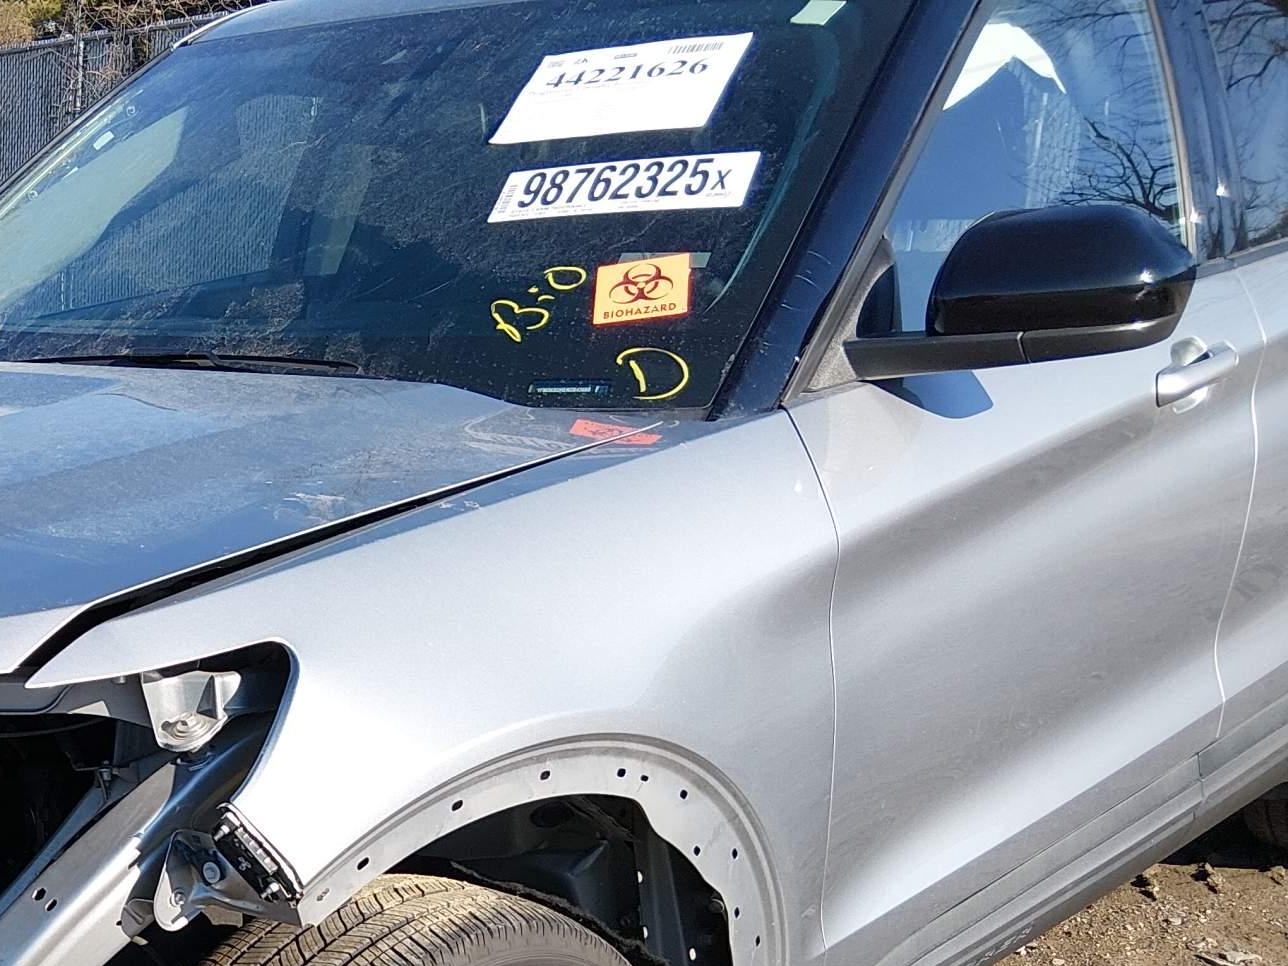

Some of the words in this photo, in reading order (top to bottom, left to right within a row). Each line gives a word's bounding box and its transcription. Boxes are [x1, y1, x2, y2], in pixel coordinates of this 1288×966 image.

[546, 57, 710, 88] 44221626
[603, 301, 678, 320] BIOHAZARD
[615, 347, 690, 400] D
